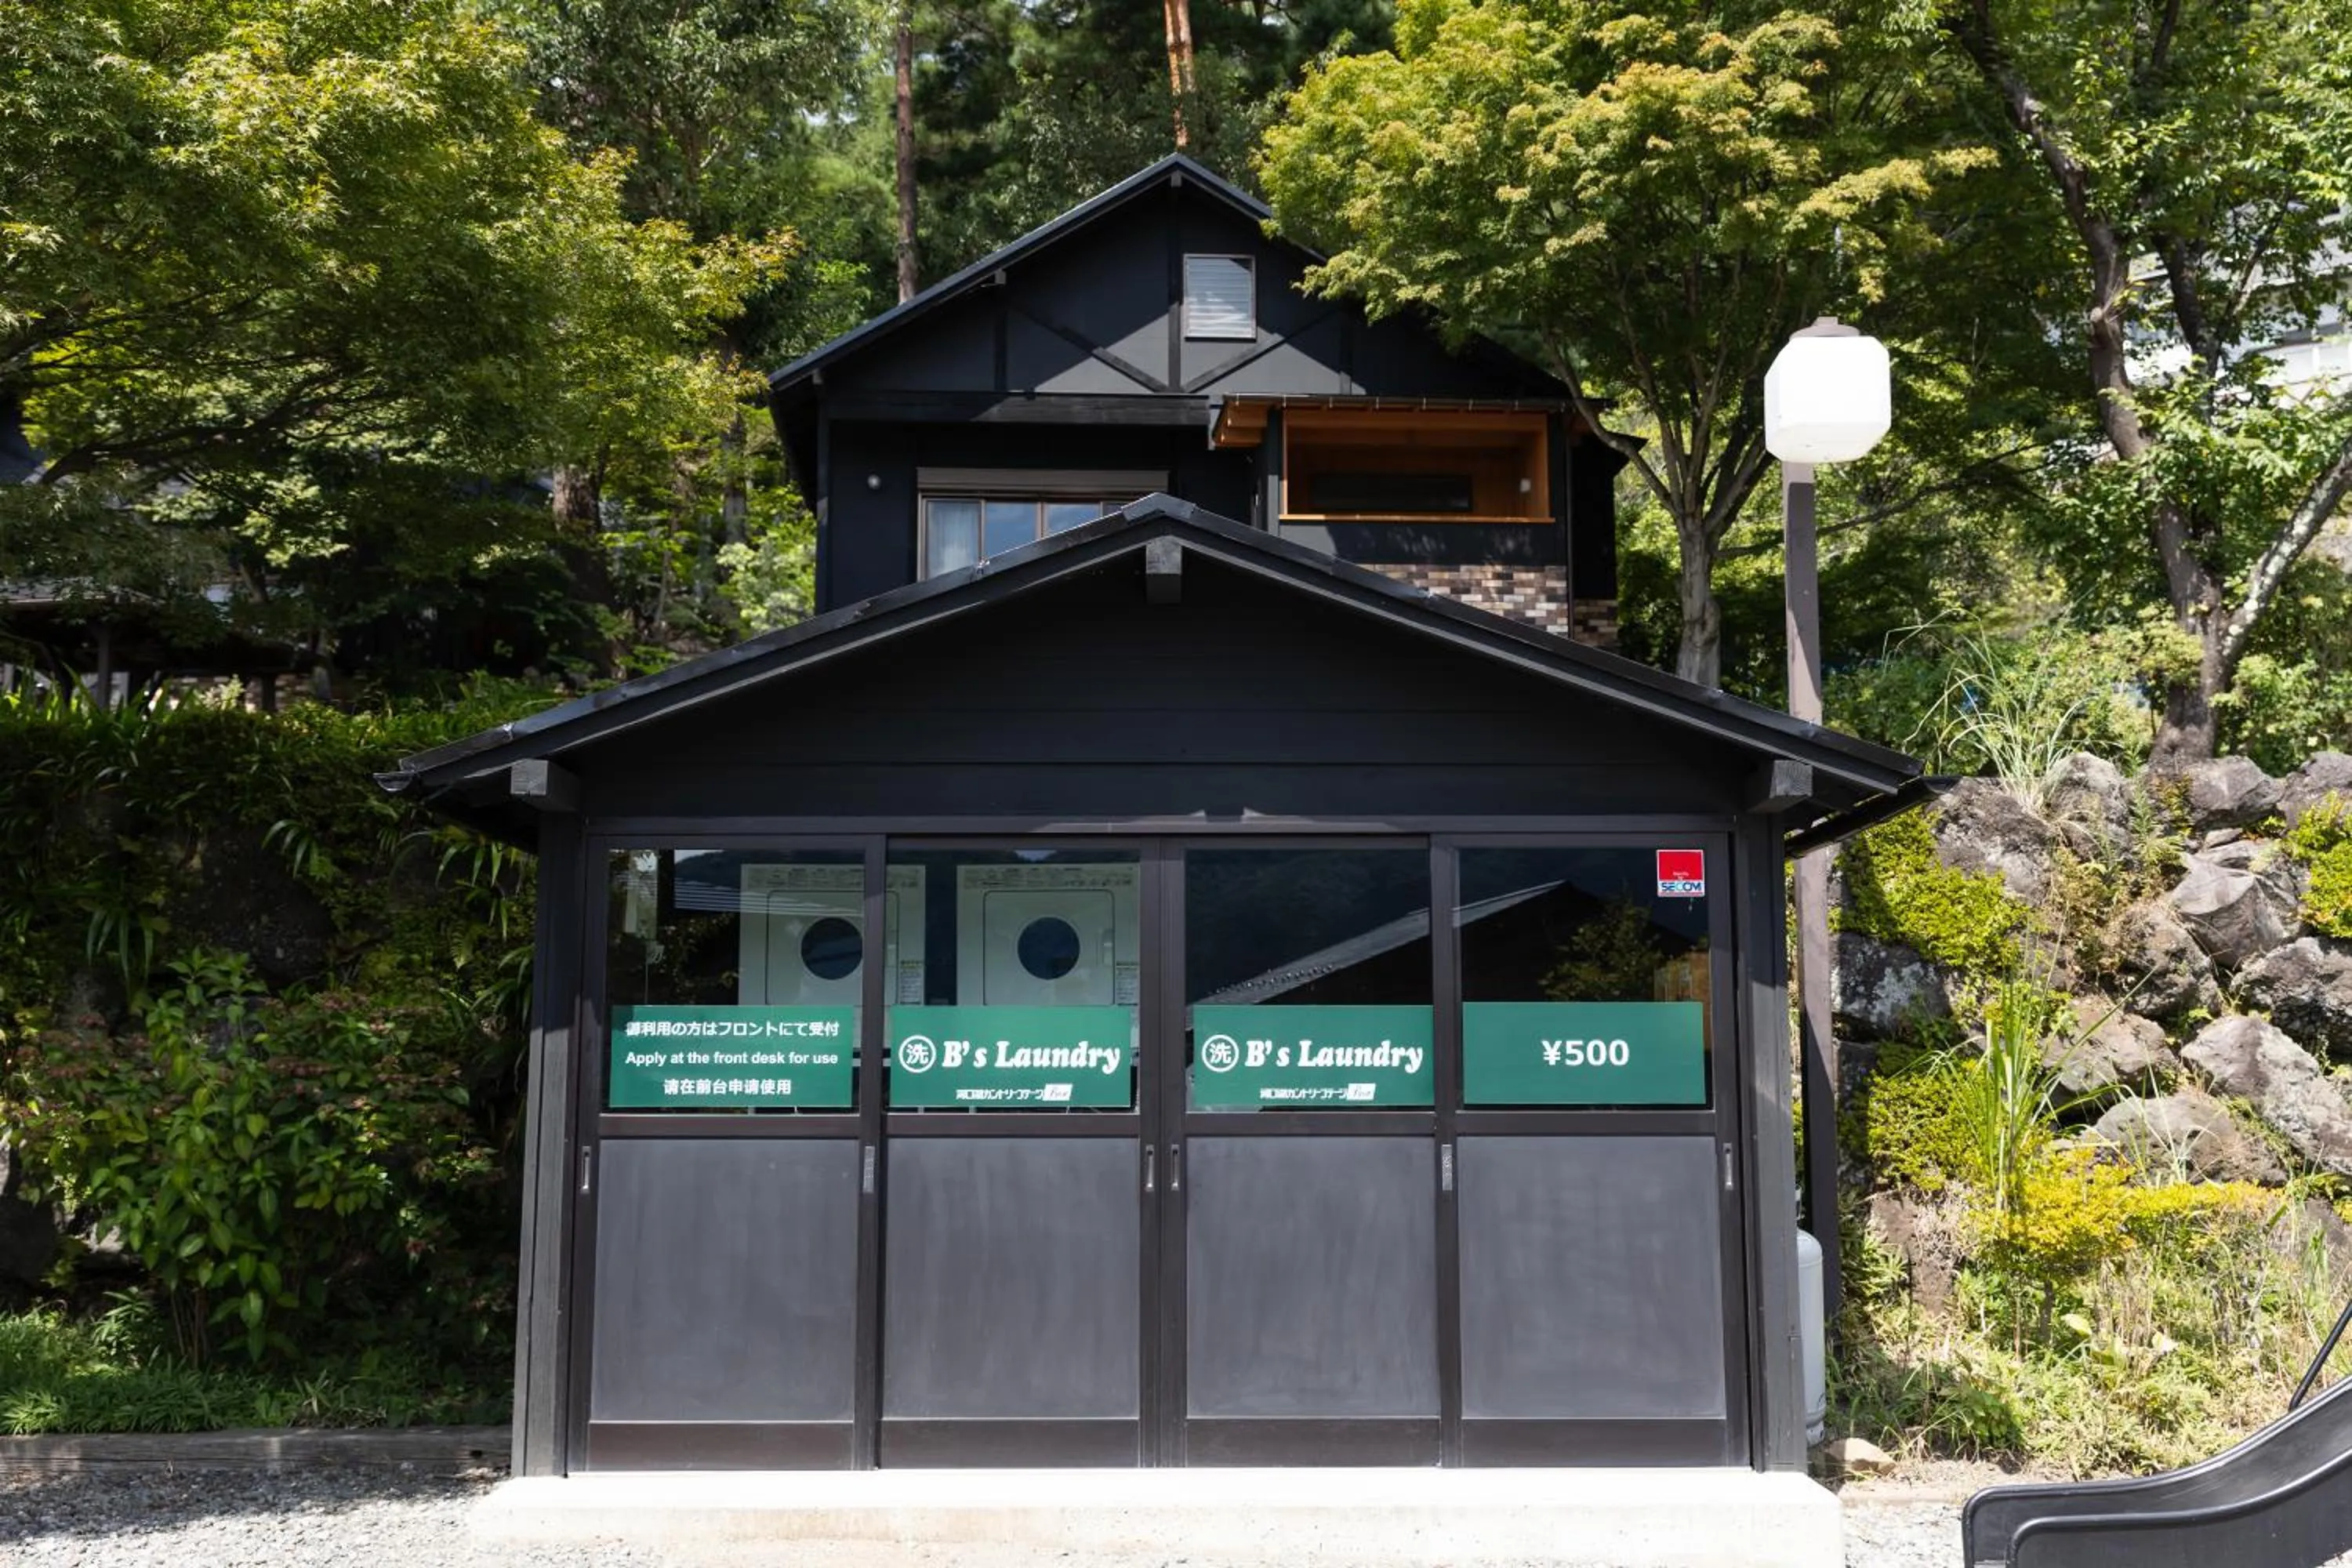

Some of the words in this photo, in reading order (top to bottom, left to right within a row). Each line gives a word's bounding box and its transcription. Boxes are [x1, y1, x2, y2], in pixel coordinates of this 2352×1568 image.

[1661, 882, 1701, 891] SECOM
[626, 1052, 666, 1067] Apply
[670, 1052, 684, 1064] at
[687, 1051, 710, 1064] the
[713, 1051, 748, 1064] front
[751, 1051, 785, 1064] desk
[789, 1051, 810, 1064] for
[813, 1054, 838, 1064] use
[995, 1040, 1120, 1074] Laundry
[1298, 1040, 1423, 1073] Laundry
[1541, 1040, 1629, 1065] ¥500
[663, 1078, 792, 1095] 请在前台申请使用
